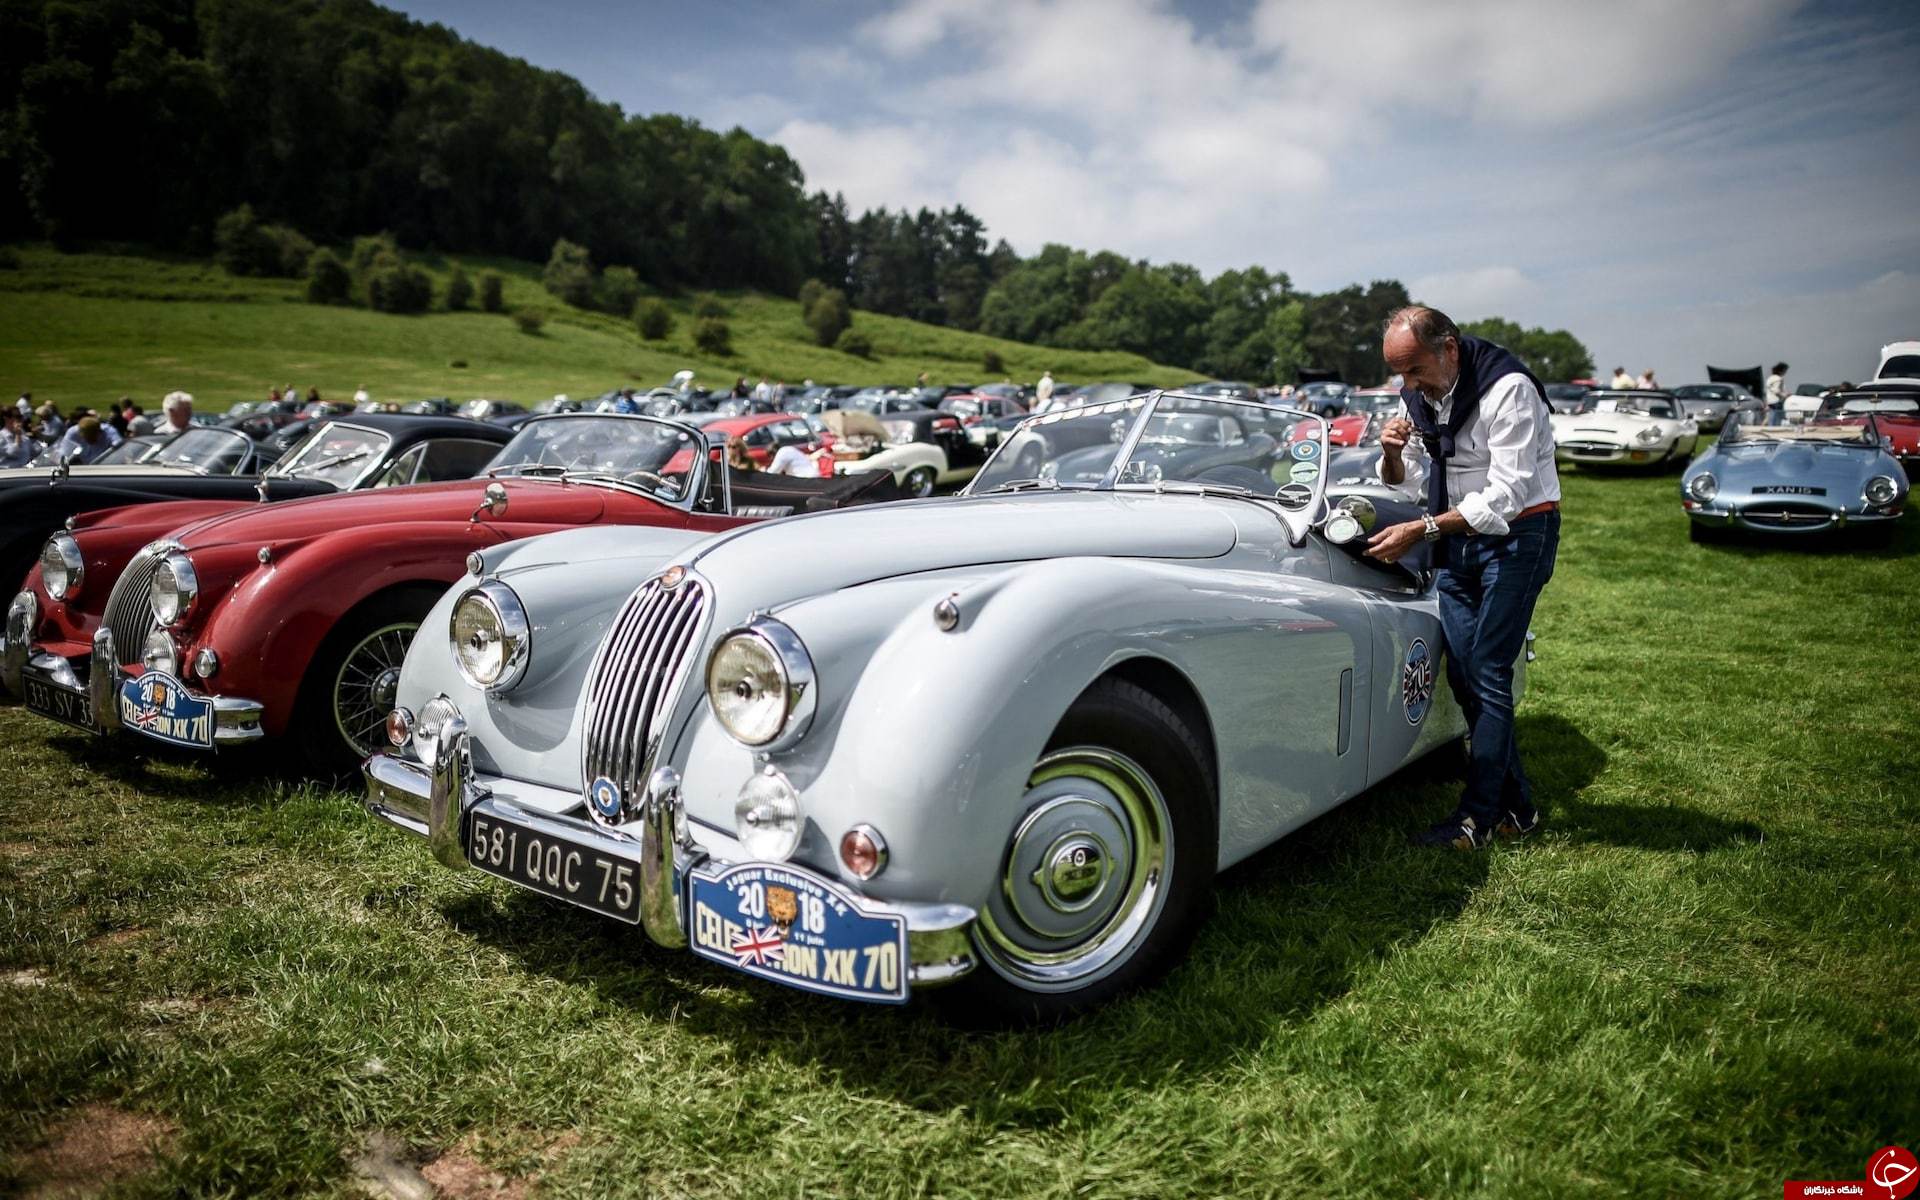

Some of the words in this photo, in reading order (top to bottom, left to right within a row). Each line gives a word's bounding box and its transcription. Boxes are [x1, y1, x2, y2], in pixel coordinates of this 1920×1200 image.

[55, 689, 73, 719] SV
[141, 682, 153, 702] 20
[166, 687, 176, 710] 18
[173, 718, 189, 740] XK
[191, 715, 209, 744] 70
[474, 821, 517, 872] 581
[526, 839, 582, 893] QQC
[596, 858, 633, 910] 75
[726, 870, 762, 891] Jaguar
[764, 869, 823, 897] Exclusive
[738, 881, 765, 919] 20
[798, 891, 825, 934] 18
[823, 949, 858, 988] XK
[863, 942, 898, 991] 70
